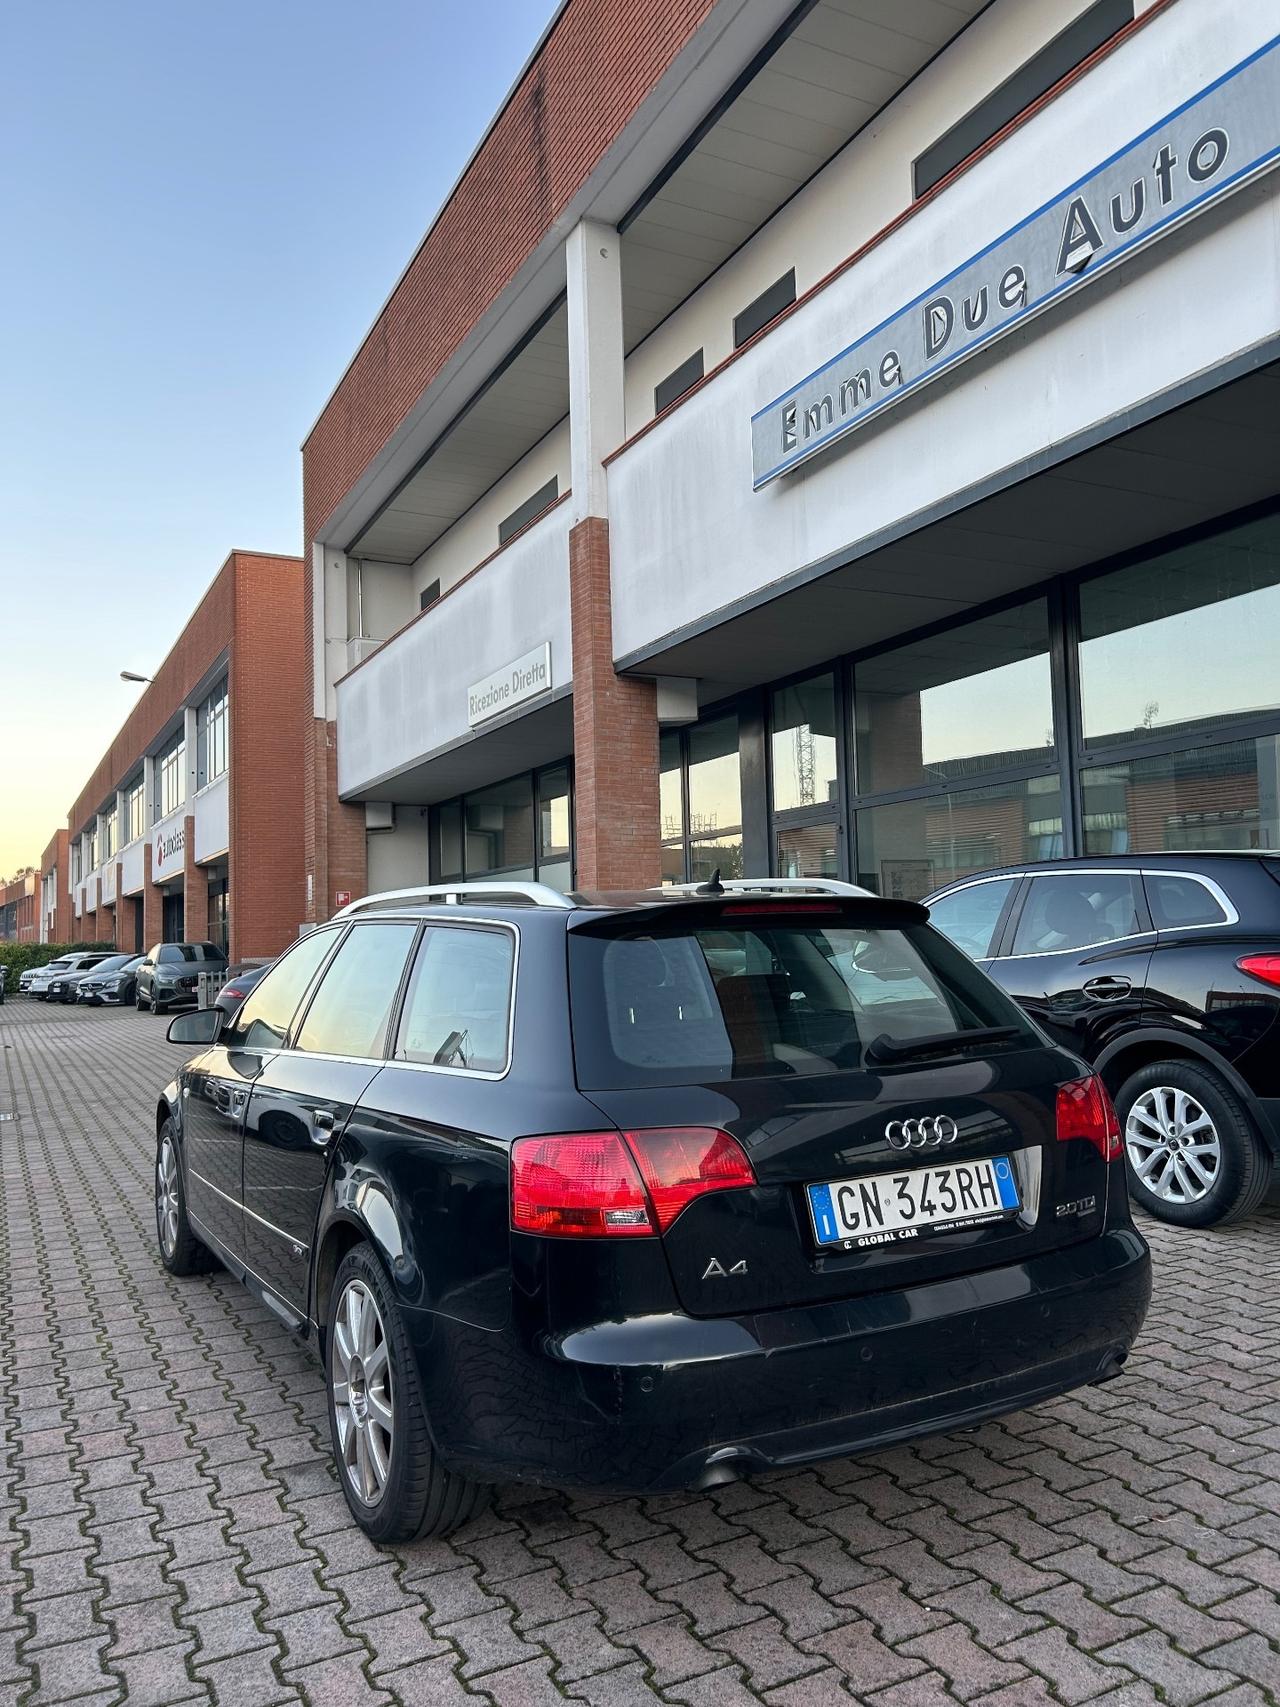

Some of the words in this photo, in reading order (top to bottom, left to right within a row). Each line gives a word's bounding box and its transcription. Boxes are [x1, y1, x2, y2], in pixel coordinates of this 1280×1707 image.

[781, 349, 902, 454] Emme
[922, 264, 1027, 360] Due
[1054, 127, 1230, 277] Auto
[469, 683, 510, 717] Ricezione
[512, 663, 546, 695] Diretta
[837, 1181, 884, 1230] GN
[893, 1164, 998, 1220] 343RH
[858, 1232, 897, 1247] GLOBAL
[898, 1228, 919, 1240] CAR
[702, 1257, 748, 1280] A4
